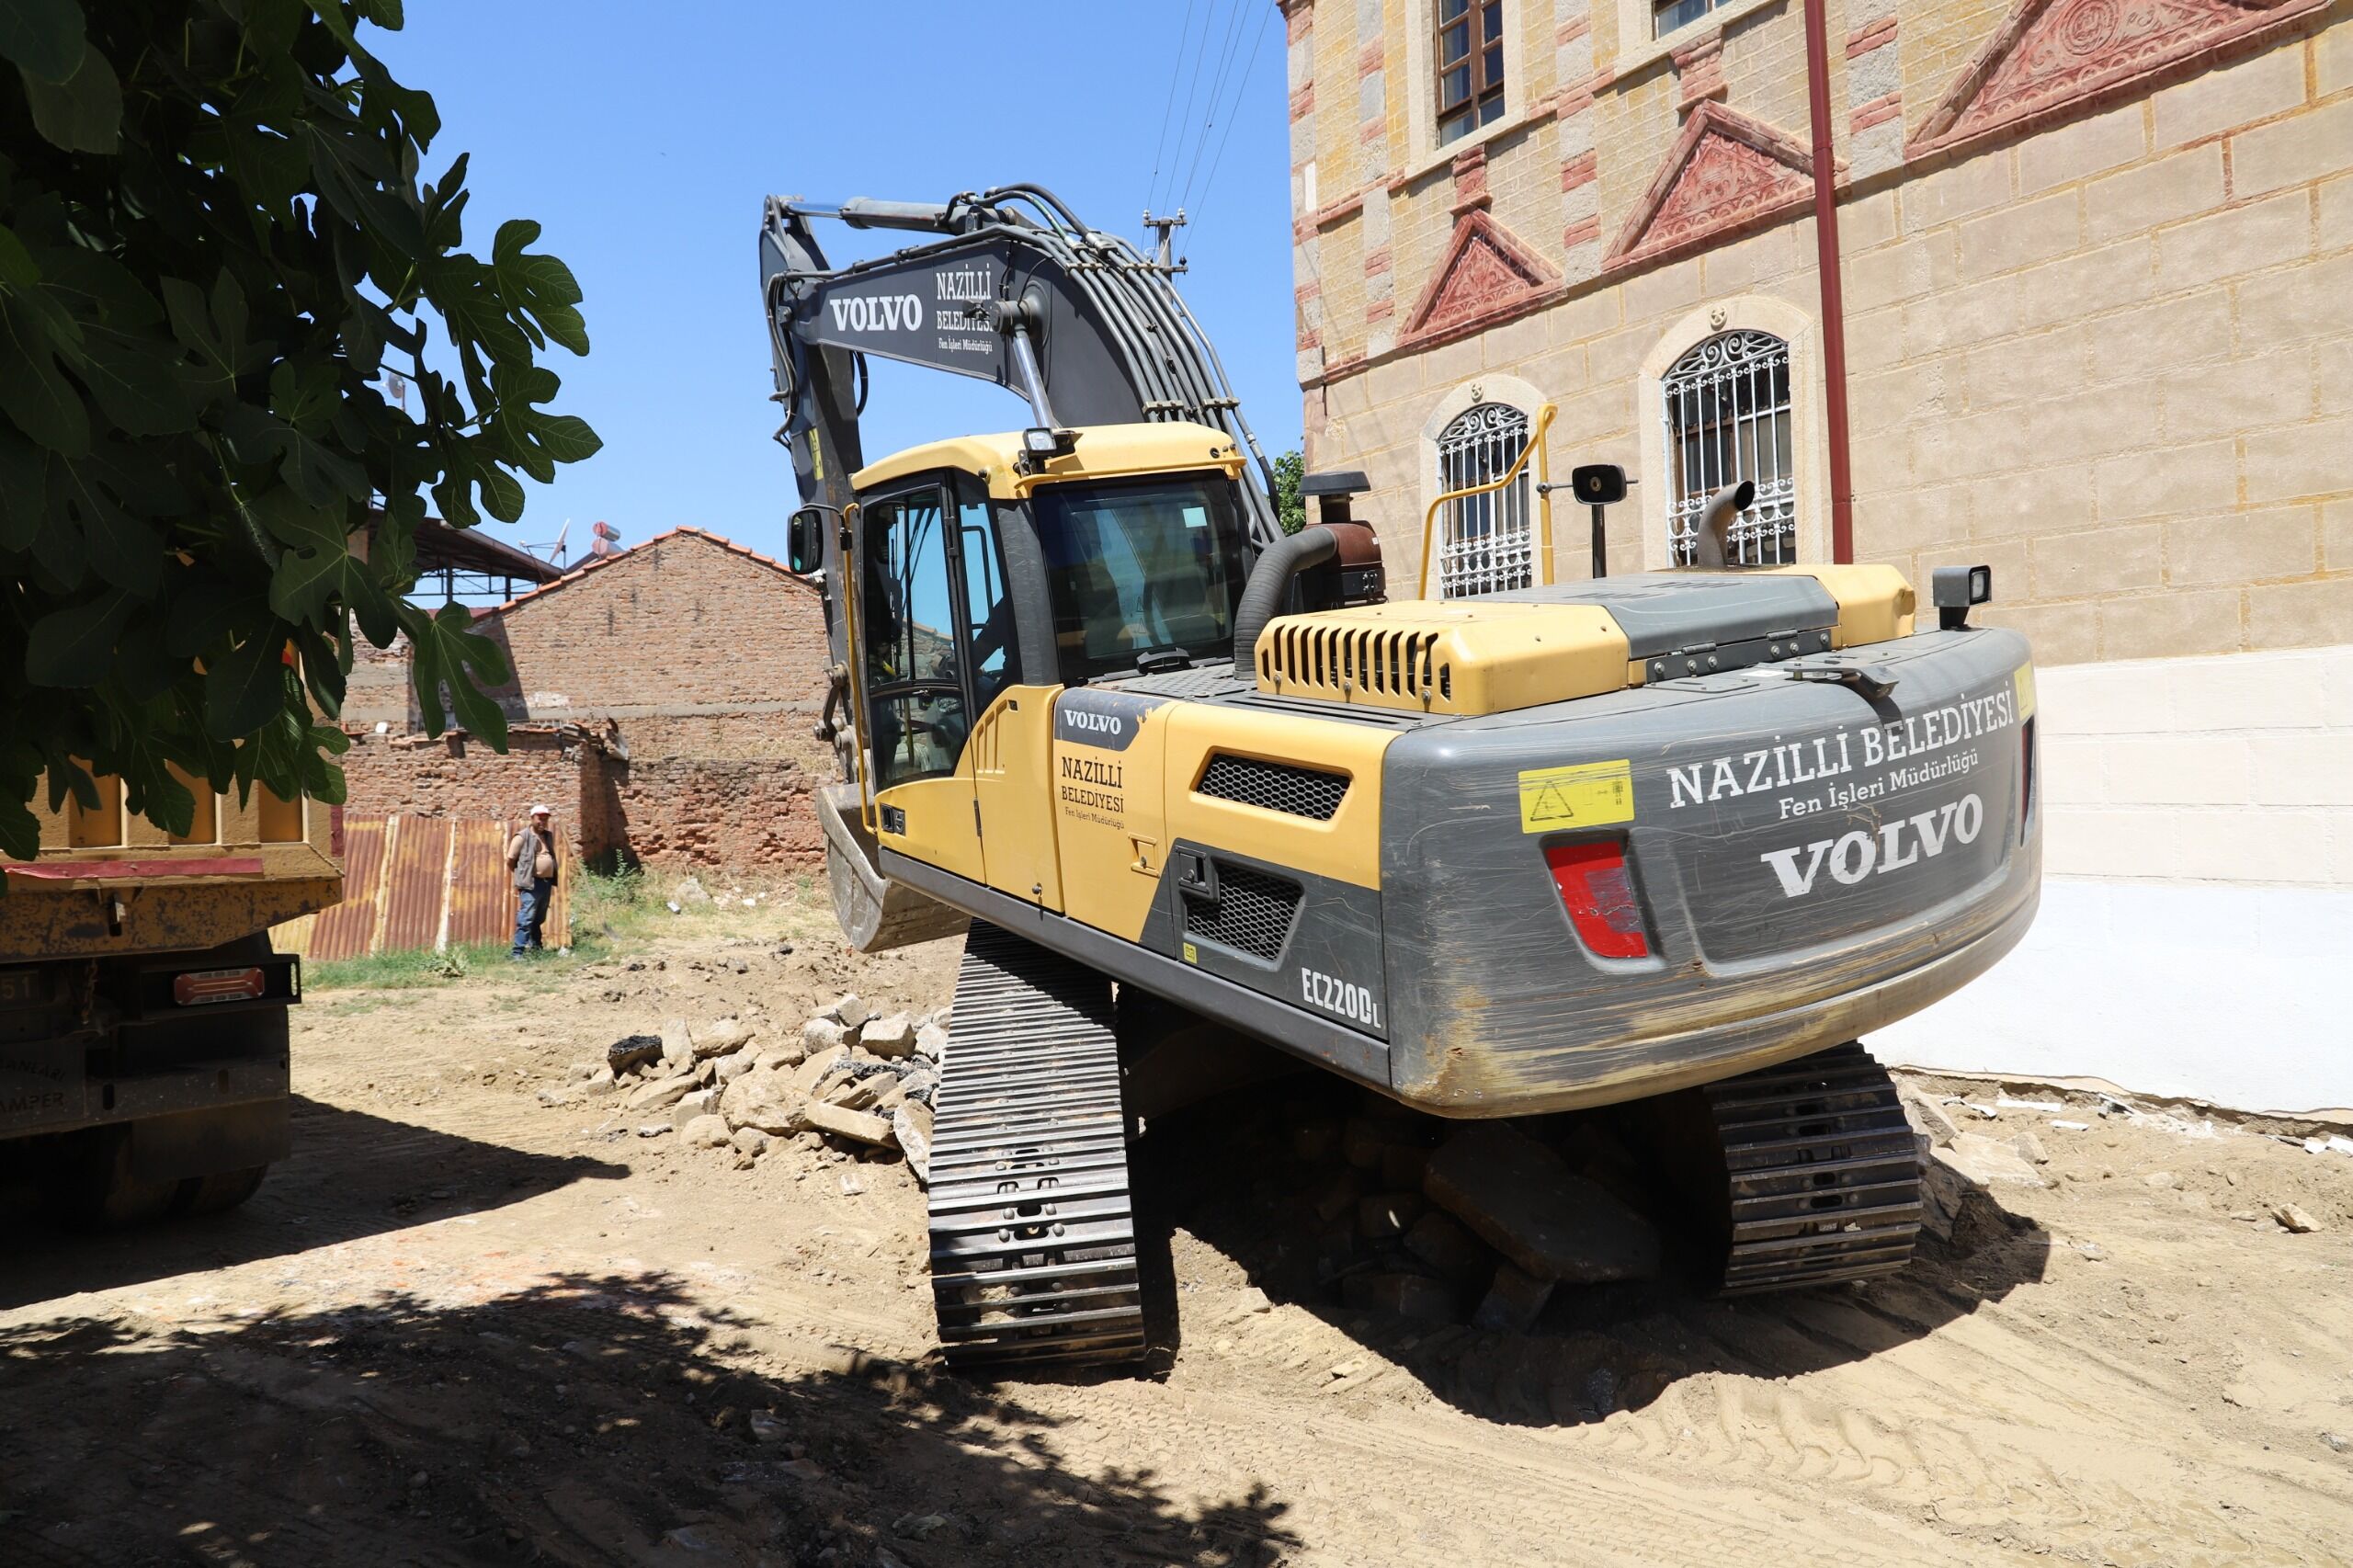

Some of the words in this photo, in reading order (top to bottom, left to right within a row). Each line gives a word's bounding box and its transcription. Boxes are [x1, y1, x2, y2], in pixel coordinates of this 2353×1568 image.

[936, 263, 992, 301] NAZİLLİ
[830, 293, 923, 332] VOLVO
[936, 306, 994, 332] BELEDES
[938, 337, 948, 349] Fen
[962, 339, 993, 355] Müdürlüğü
[1064, 709, 1122, 735] VOLVO
[1666, 725, 1852, 809] NAZİLLİ
[1860, 681, 2014, 767] BELEDİYESİ
[1062, 756, 1123, 790] NAZİLLİ
[1779, 797, 1823, 820] Fen
[1828, 776, 1885, 811] İşleri
[1890, 747, 1979, 791] Müdürlüğü
[1061, 785, 1124, 813] BELEDİYESİ
[1065, 806, 1074, 816] Fen
[1760, 793, 1983, 899] VOLVO
